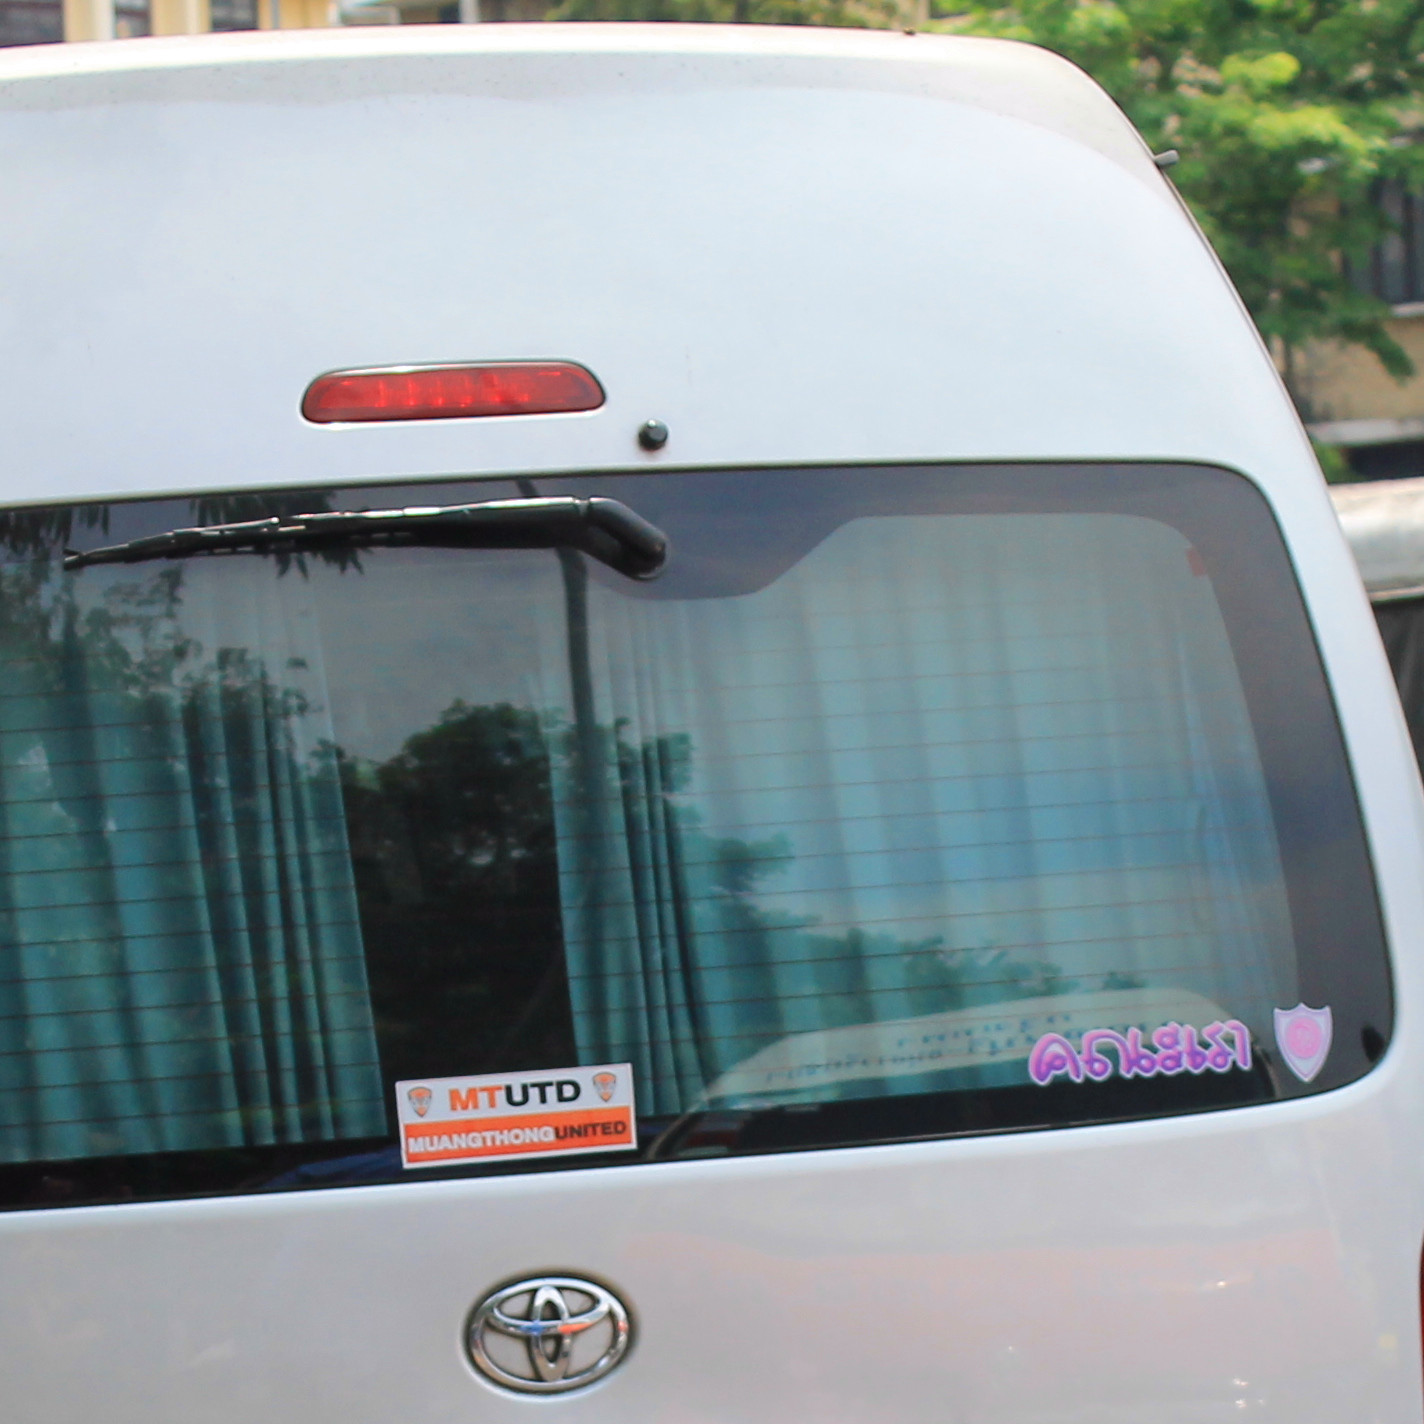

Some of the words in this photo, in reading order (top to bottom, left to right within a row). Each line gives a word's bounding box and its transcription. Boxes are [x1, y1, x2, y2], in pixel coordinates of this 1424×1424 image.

[1029, 1018, 1253, 1086] คณะเรา
[448, 1078, 582, 1112] MTUTD
